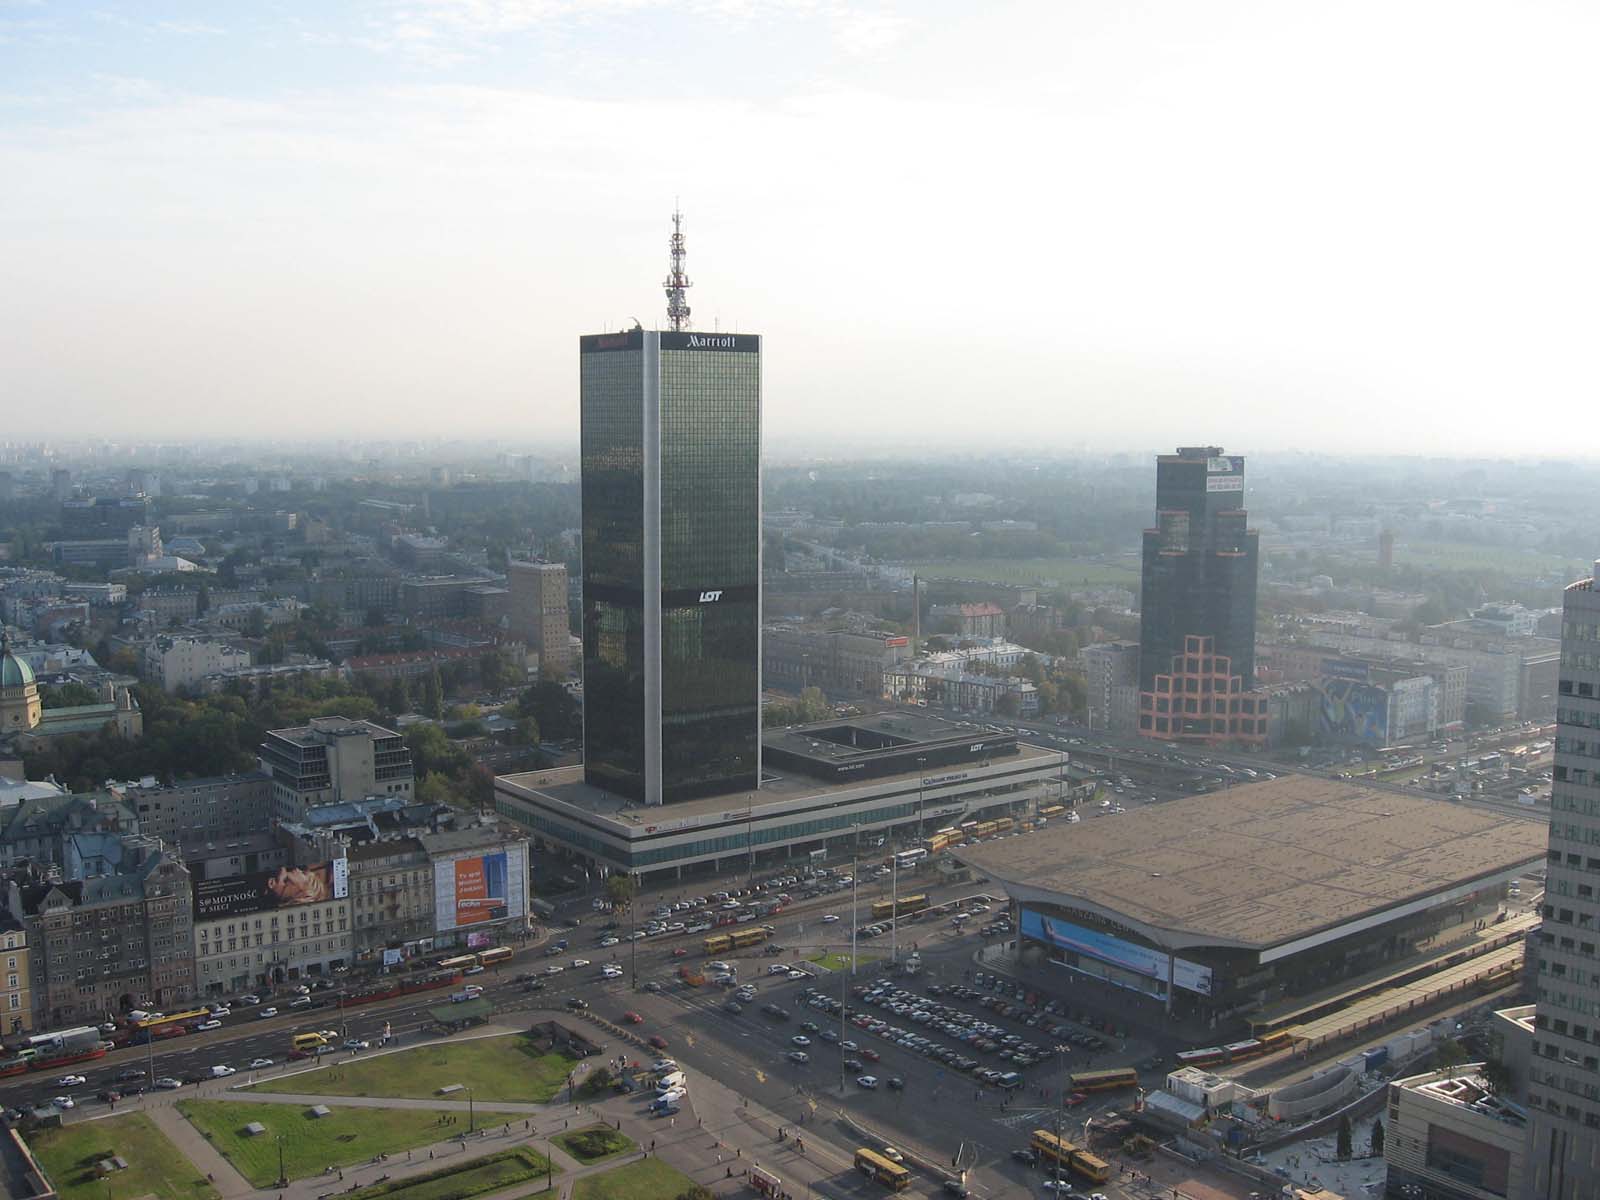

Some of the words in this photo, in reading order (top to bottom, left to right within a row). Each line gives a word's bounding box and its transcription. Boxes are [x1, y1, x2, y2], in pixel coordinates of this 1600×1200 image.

[687, 335, 736, 347] Marriott
[699, 591, 722, 603] LOT
[970, 744, 984, 752] LOT
